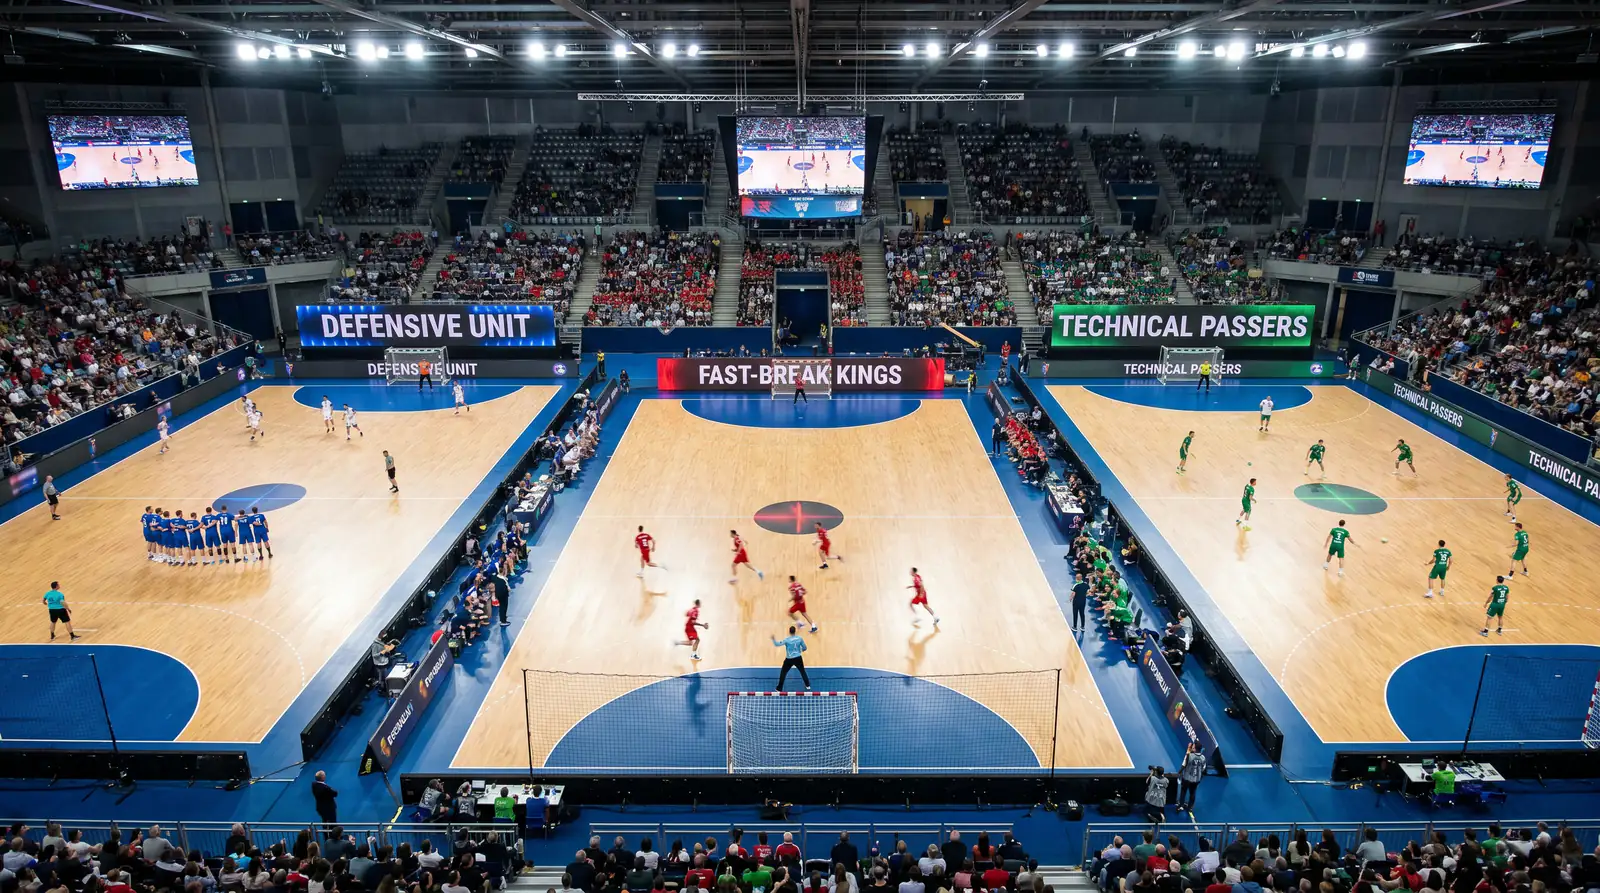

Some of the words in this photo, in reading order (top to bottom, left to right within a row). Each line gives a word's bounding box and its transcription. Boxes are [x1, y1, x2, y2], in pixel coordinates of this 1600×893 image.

[321, 313, 463, 338] DEFENSIVE
[468, 313, 531, 338] UNIT
[1059, 314, 1193, 337] TECHNICAL
[1200, 314, 1308, 337] PASSERS
[367, 363, 443, 375] DEFENSVE
[446, 363, 478, 375] UNIT
[699, 364, 830, 385] FAST-BREAK
[836, 364, 902, 385] KINGS
[1124, 363, 1187, 374] TECHNICAL
[1190, 363, 1242, 374] PSERS
[1393, 383, 1429, 411] TECHNICAL
[1429, 401, 1463, 428] PASSERS
[1529, 450, 1582, 490] TECHNICAL
[1584, 479, 1600, 500] PA
